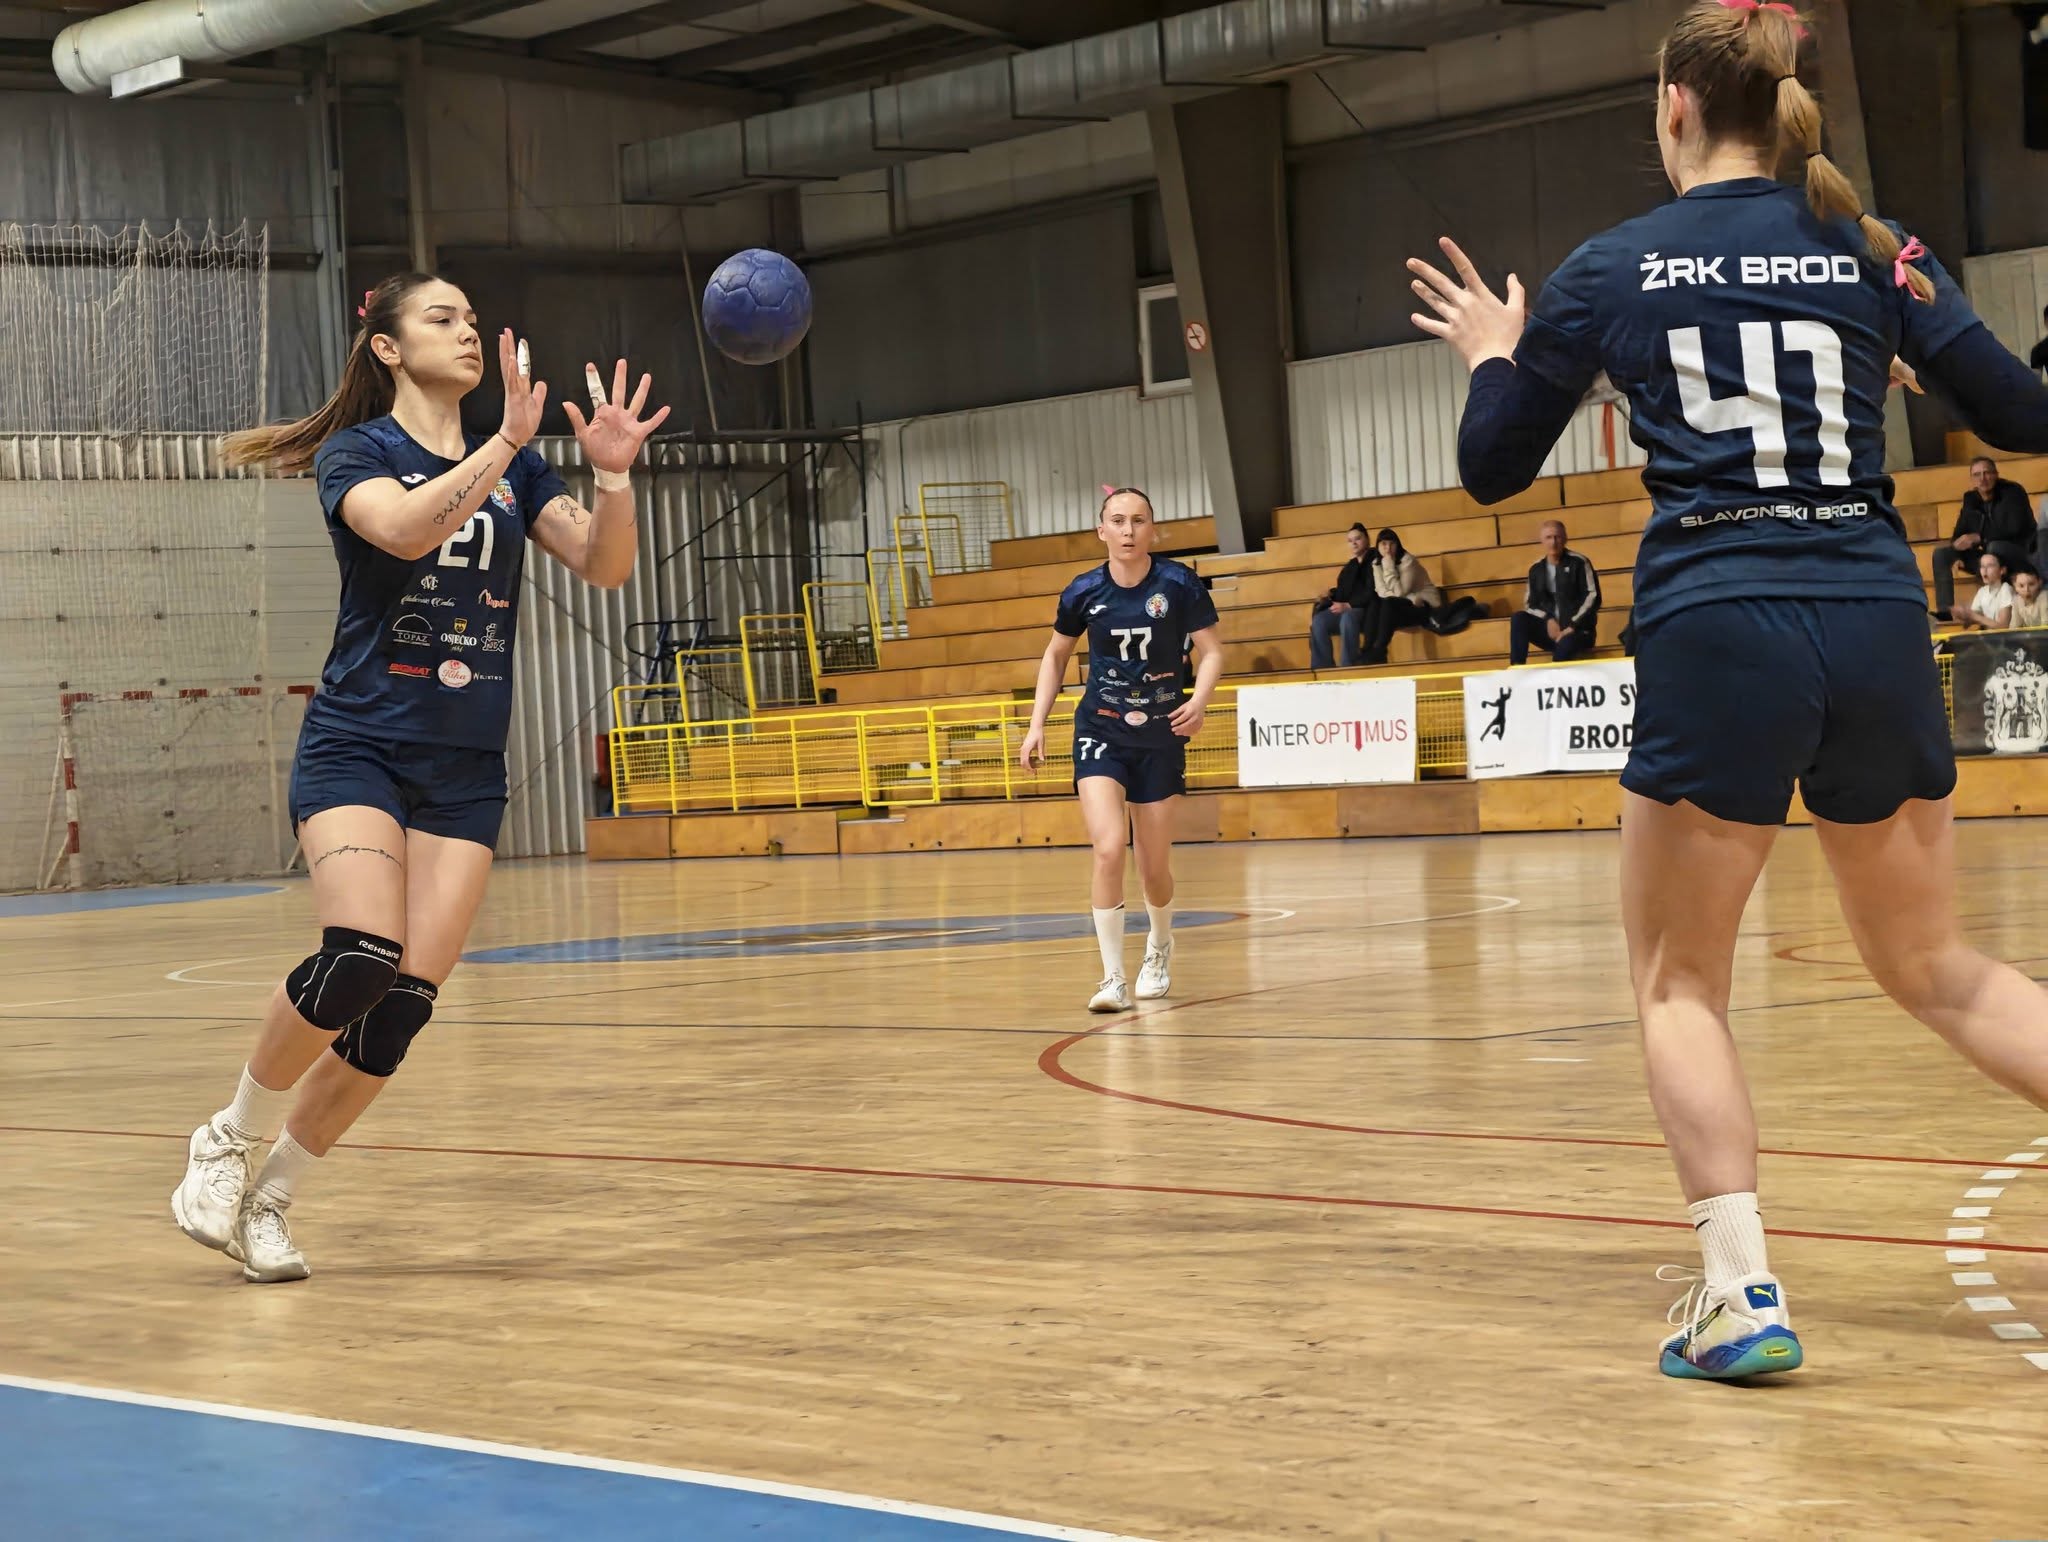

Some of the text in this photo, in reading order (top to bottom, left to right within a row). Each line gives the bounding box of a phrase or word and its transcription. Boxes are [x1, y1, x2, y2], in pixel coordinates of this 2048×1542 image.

[1640, 252, 1860, 291] ŽRK BROD
[1679, 503, 1868, 528] SLAVONSKI BROD
[437, 511, 494, 571] 21
[397, 632, 428, 643] TOPAZ
[1110, 626, 1153, 662] 77
[1537, 685, 1606, 711] IZNAD
[1249, 717, 1408, 752] INTER OPTIMUS
[1569, 724, 1634, 750] BROD
[1078, 737, 1108, 761] 77
